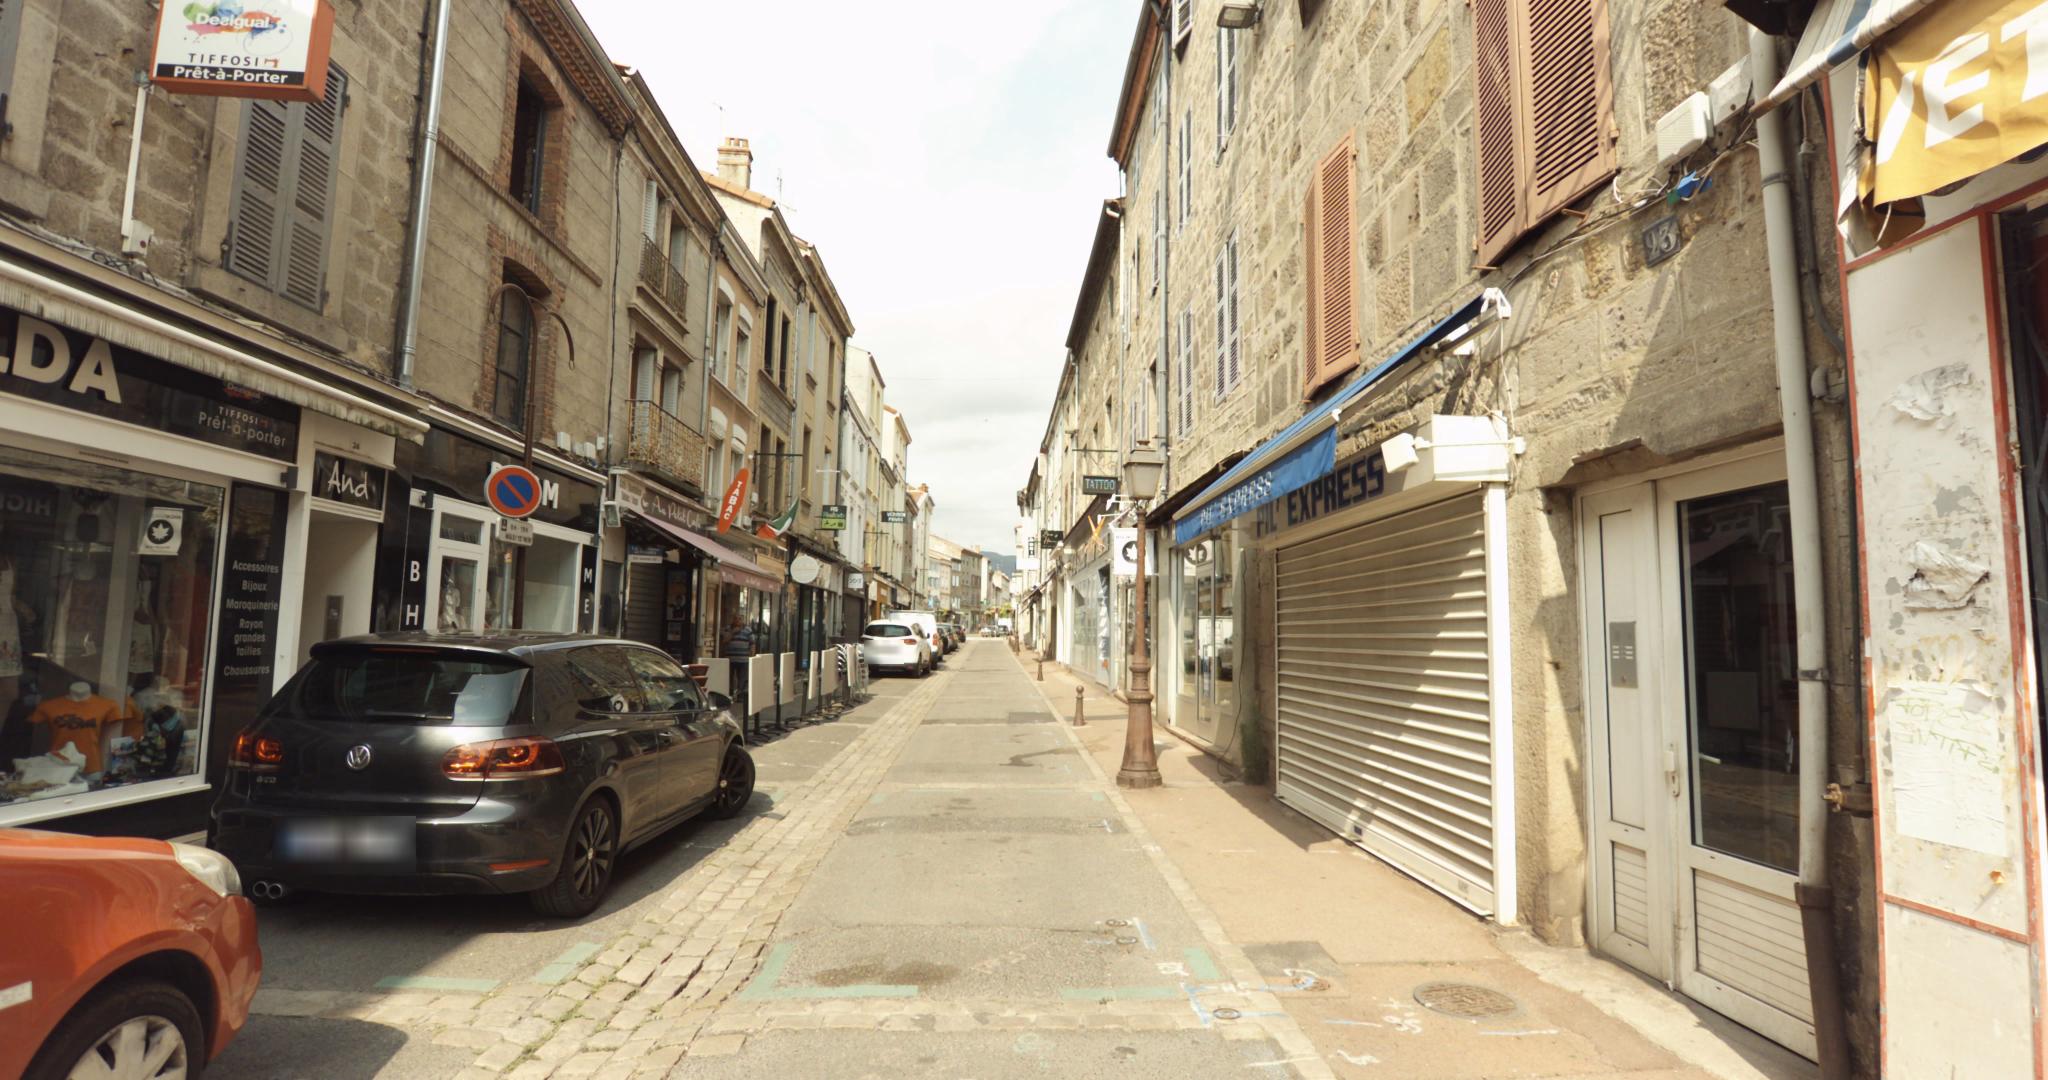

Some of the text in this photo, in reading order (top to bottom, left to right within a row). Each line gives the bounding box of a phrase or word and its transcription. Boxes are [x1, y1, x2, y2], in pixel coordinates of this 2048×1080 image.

[188, 53, 259, 67] TIFFOSI
[173, 65, 289, 85] Prêt-à-Porter
[218, 405, 259, 425] TIFFOSI
[198, 411, 287, 447] Prêt-à-porter
[327, 460, 369, 500] And
[1085, 478, 1116, 491] TATTOO
[1286, 451, 1385, 528] EXPRESS
[723, 480, 743, 521] TABAC
[232, 559, 279, 574] Accessoires
[241, 579, 267, 592] Bijoux
[226, 598, 278, 612] Maroquinerie
[239, 618, 263, 631] Rayon
[234, 633, 266, 645] grandes
[224, 664, 270, 677] Chaussures
